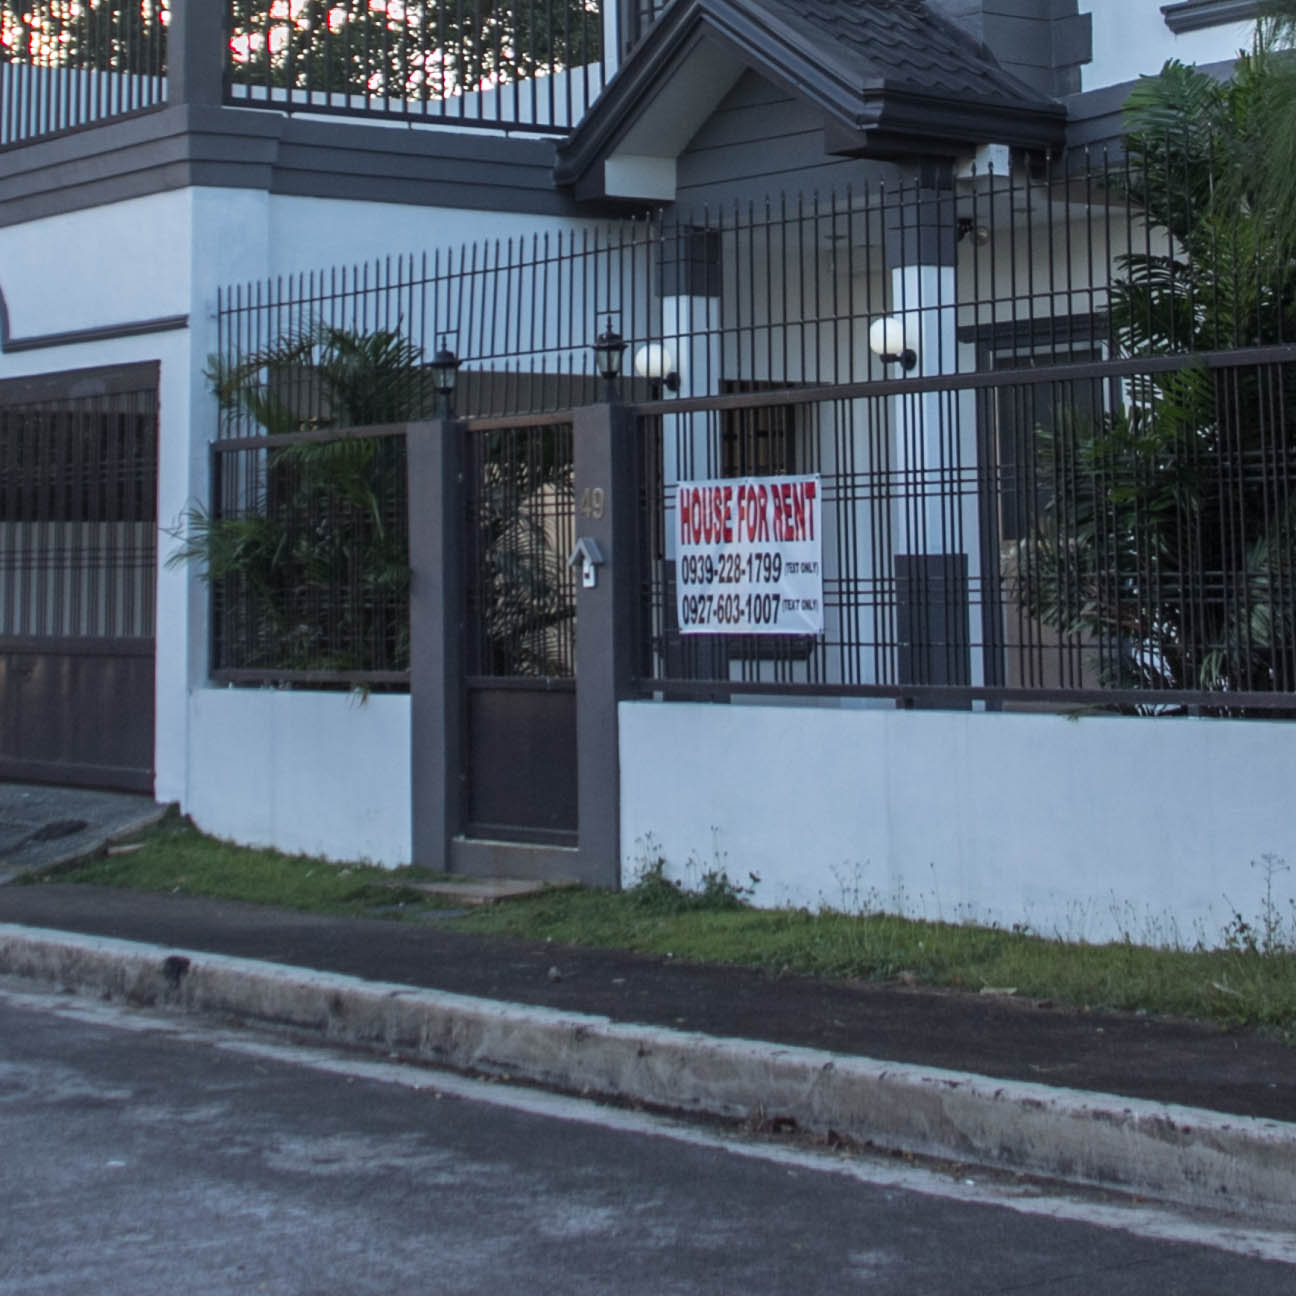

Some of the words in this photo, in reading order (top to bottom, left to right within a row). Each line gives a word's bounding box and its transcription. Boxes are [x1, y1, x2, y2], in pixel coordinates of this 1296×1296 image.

[579, 487, 604, 519] 49
[680, 486, 733, 545] HOUSE
[737, 484, 769, 543] FOR
[771, 481, 817, 542] RENT
[681, 552, 782, 584] 0939-228-1799
[682, 594, 781, 625] 0927-603-1007
